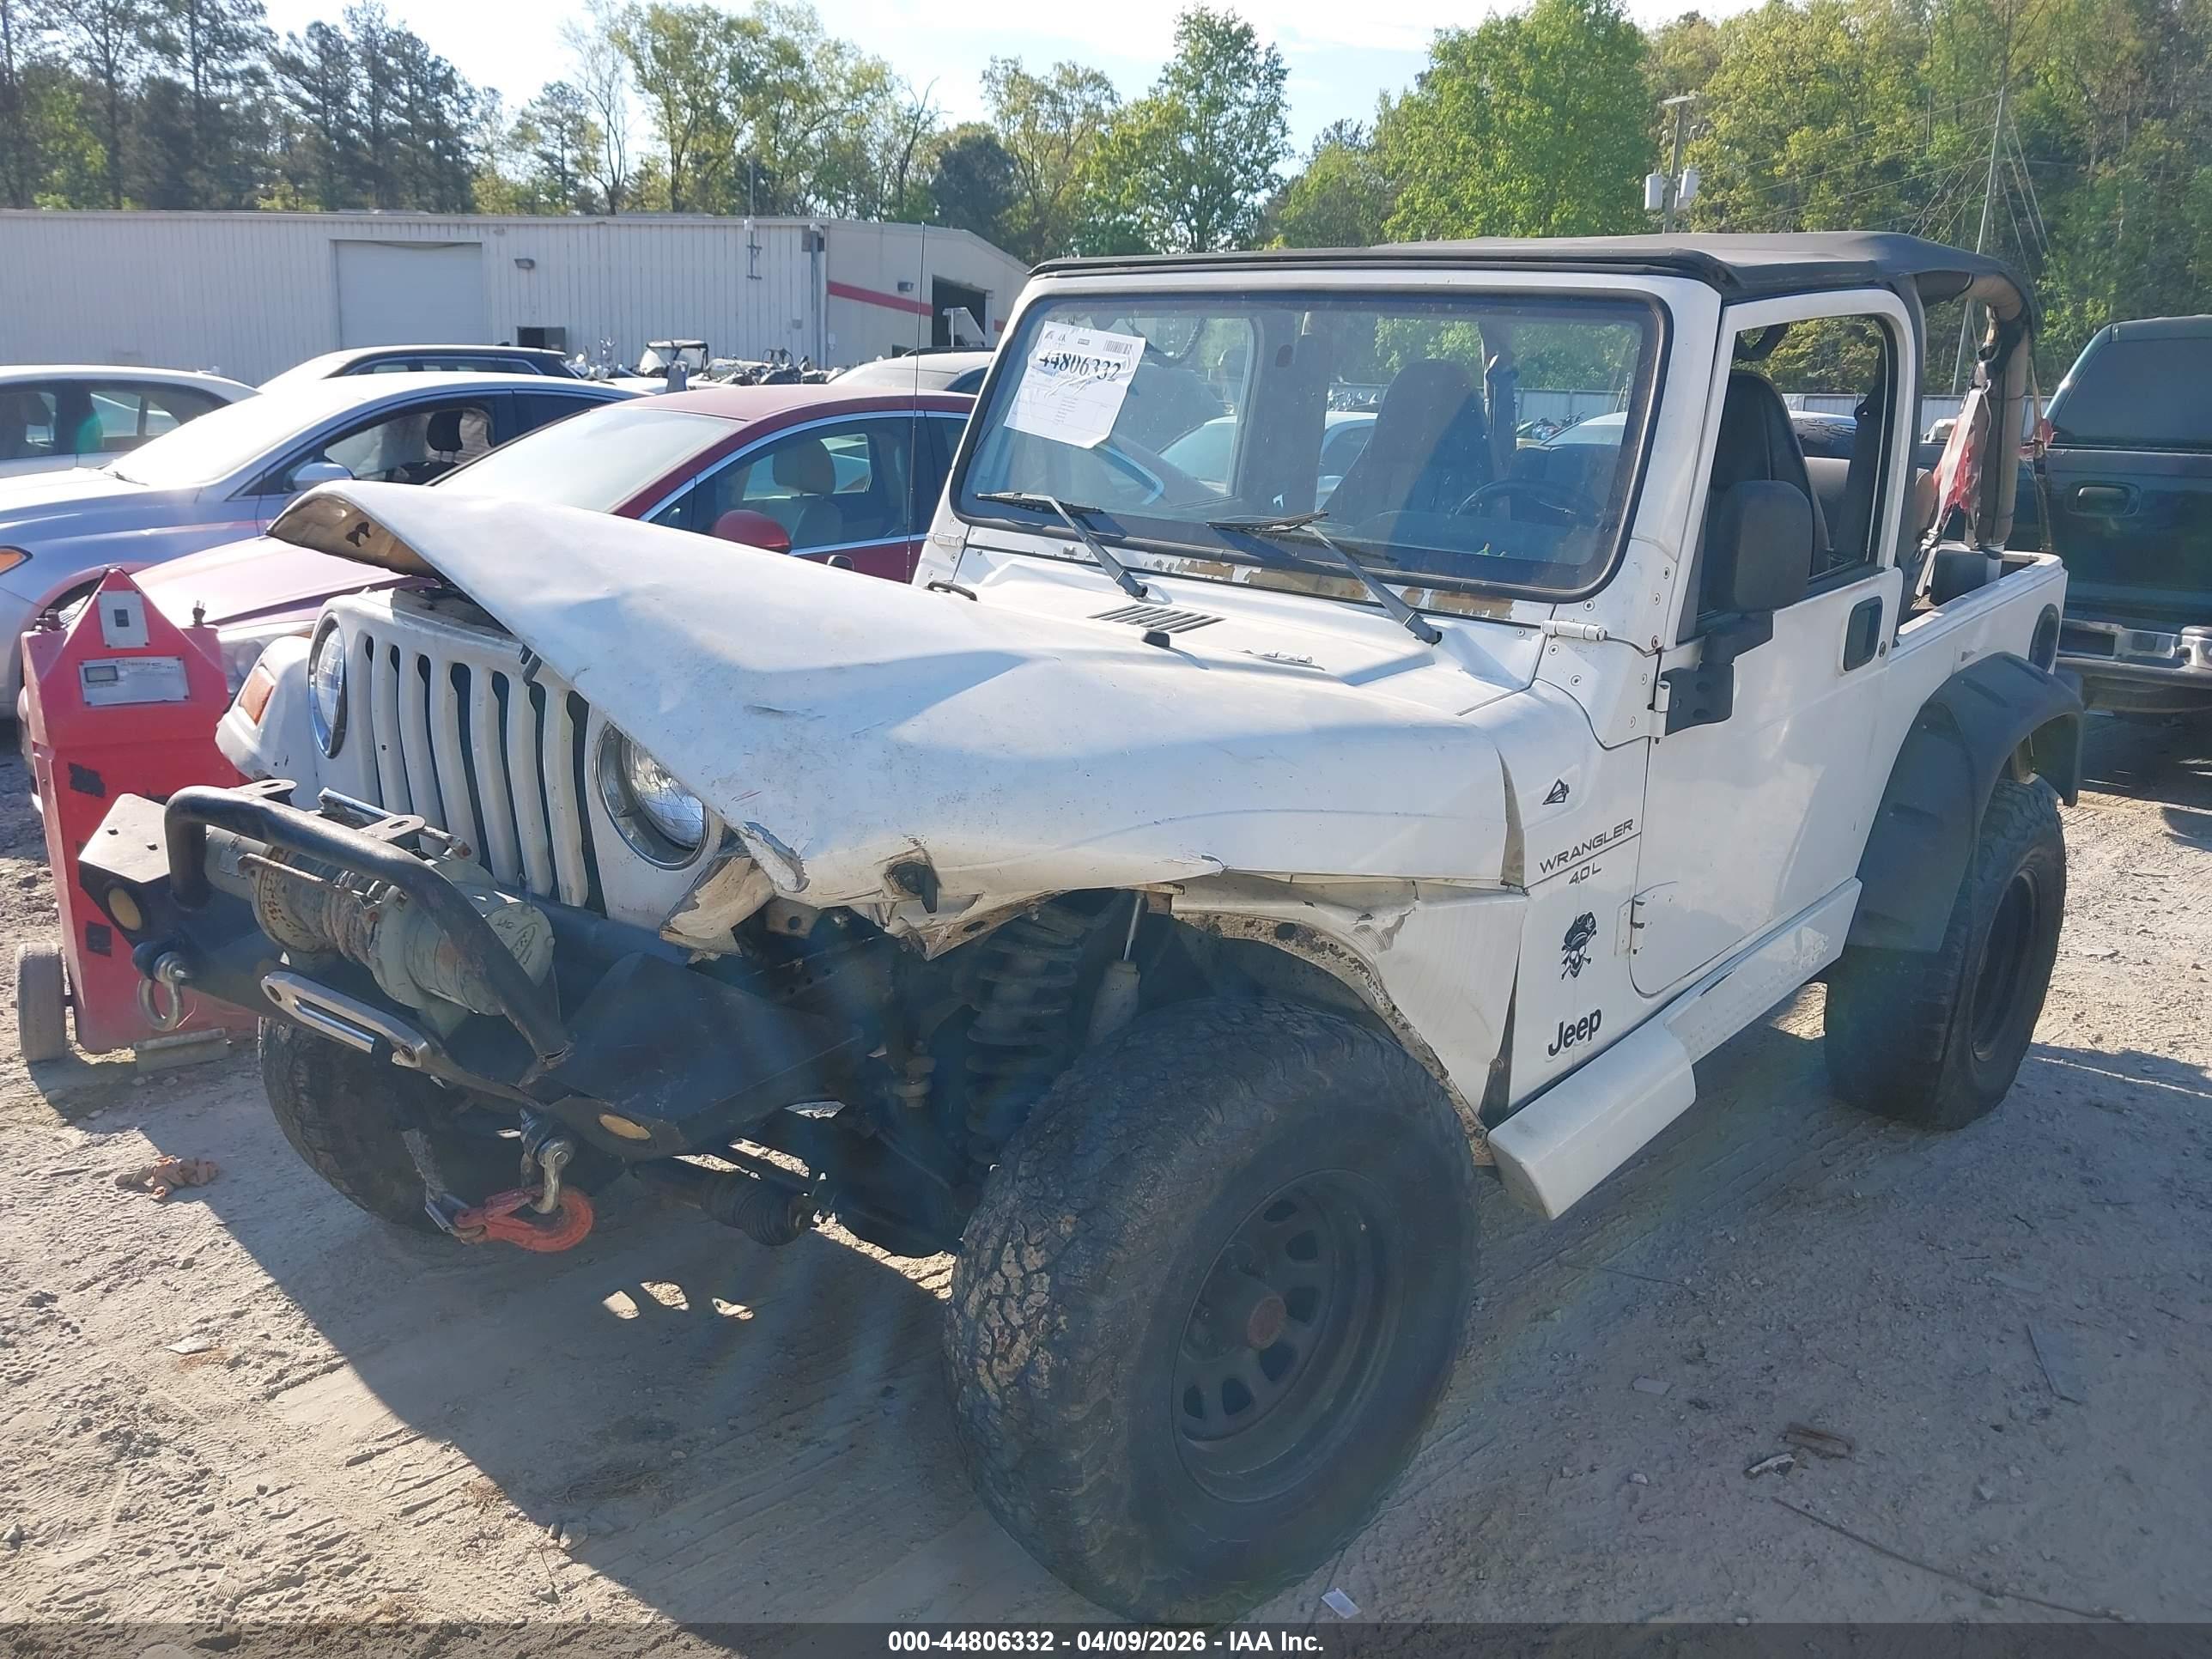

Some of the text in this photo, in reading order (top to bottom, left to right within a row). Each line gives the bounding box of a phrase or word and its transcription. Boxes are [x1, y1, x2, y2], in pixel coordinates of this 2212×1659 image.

[1039, 352, 1121, 382] 44806332
[1540, 818, 1633, 874] WRANGLER
[1547, 1008, 1602, 1057] Jeep
